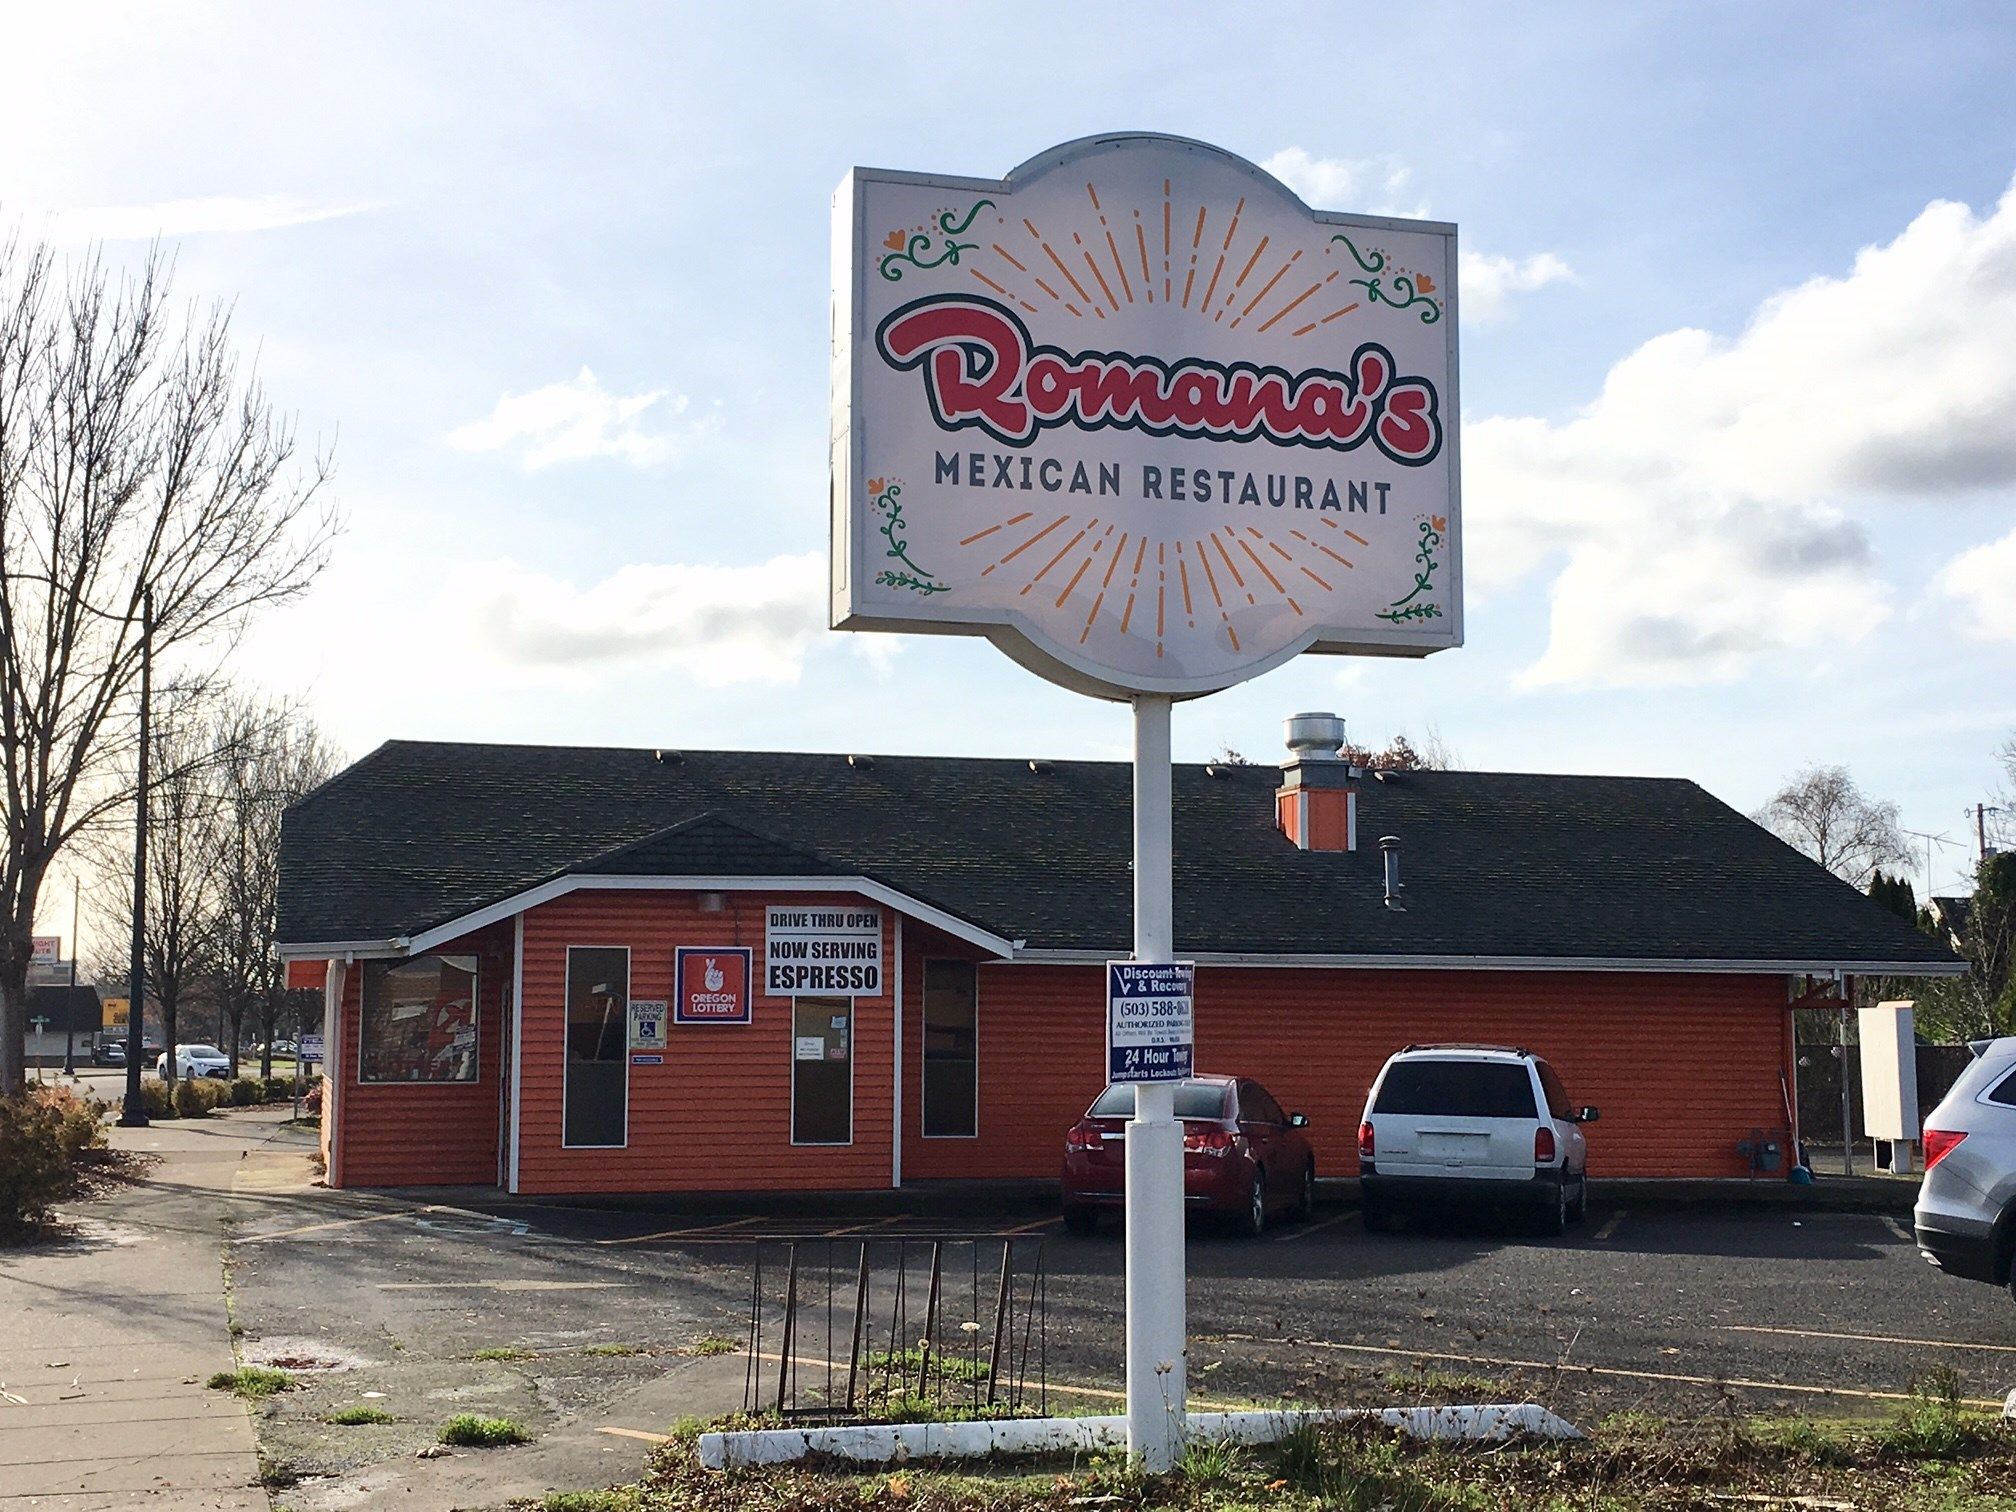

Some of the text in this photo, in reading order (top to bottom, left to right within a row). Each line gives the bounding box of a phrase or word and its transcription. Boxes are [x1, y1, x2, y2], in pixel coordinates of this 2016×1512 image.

[879, 297, 1438, 463] Romana's
[934, 449, 1392, 515] MEXICAN RESTAURANT
[770, 913, 878, 928] DRIVE THRU OPEN
[770, 942, 877, 959] NOW SERVING
[770, 965, 878, 989] ESPRESSO
[1123, 967, 1173, 979] Discount
[1137, 980, 1147, 992] &
[691, 993, 737, 1003] OREGON
[631, 1003, 665, 1012] RESERVED
[692, 1003, 736, 1013] LOTTERY
[1120, 1001, 1149, 1018] (503)
[633, 1012, 662, 1021] PARKING
[1116, 1020, 1165, 1028] AUTHORIZED
[1125, 1049, 1140, 1065] 24
[1143, 1049, 1169, 1064] Hour
